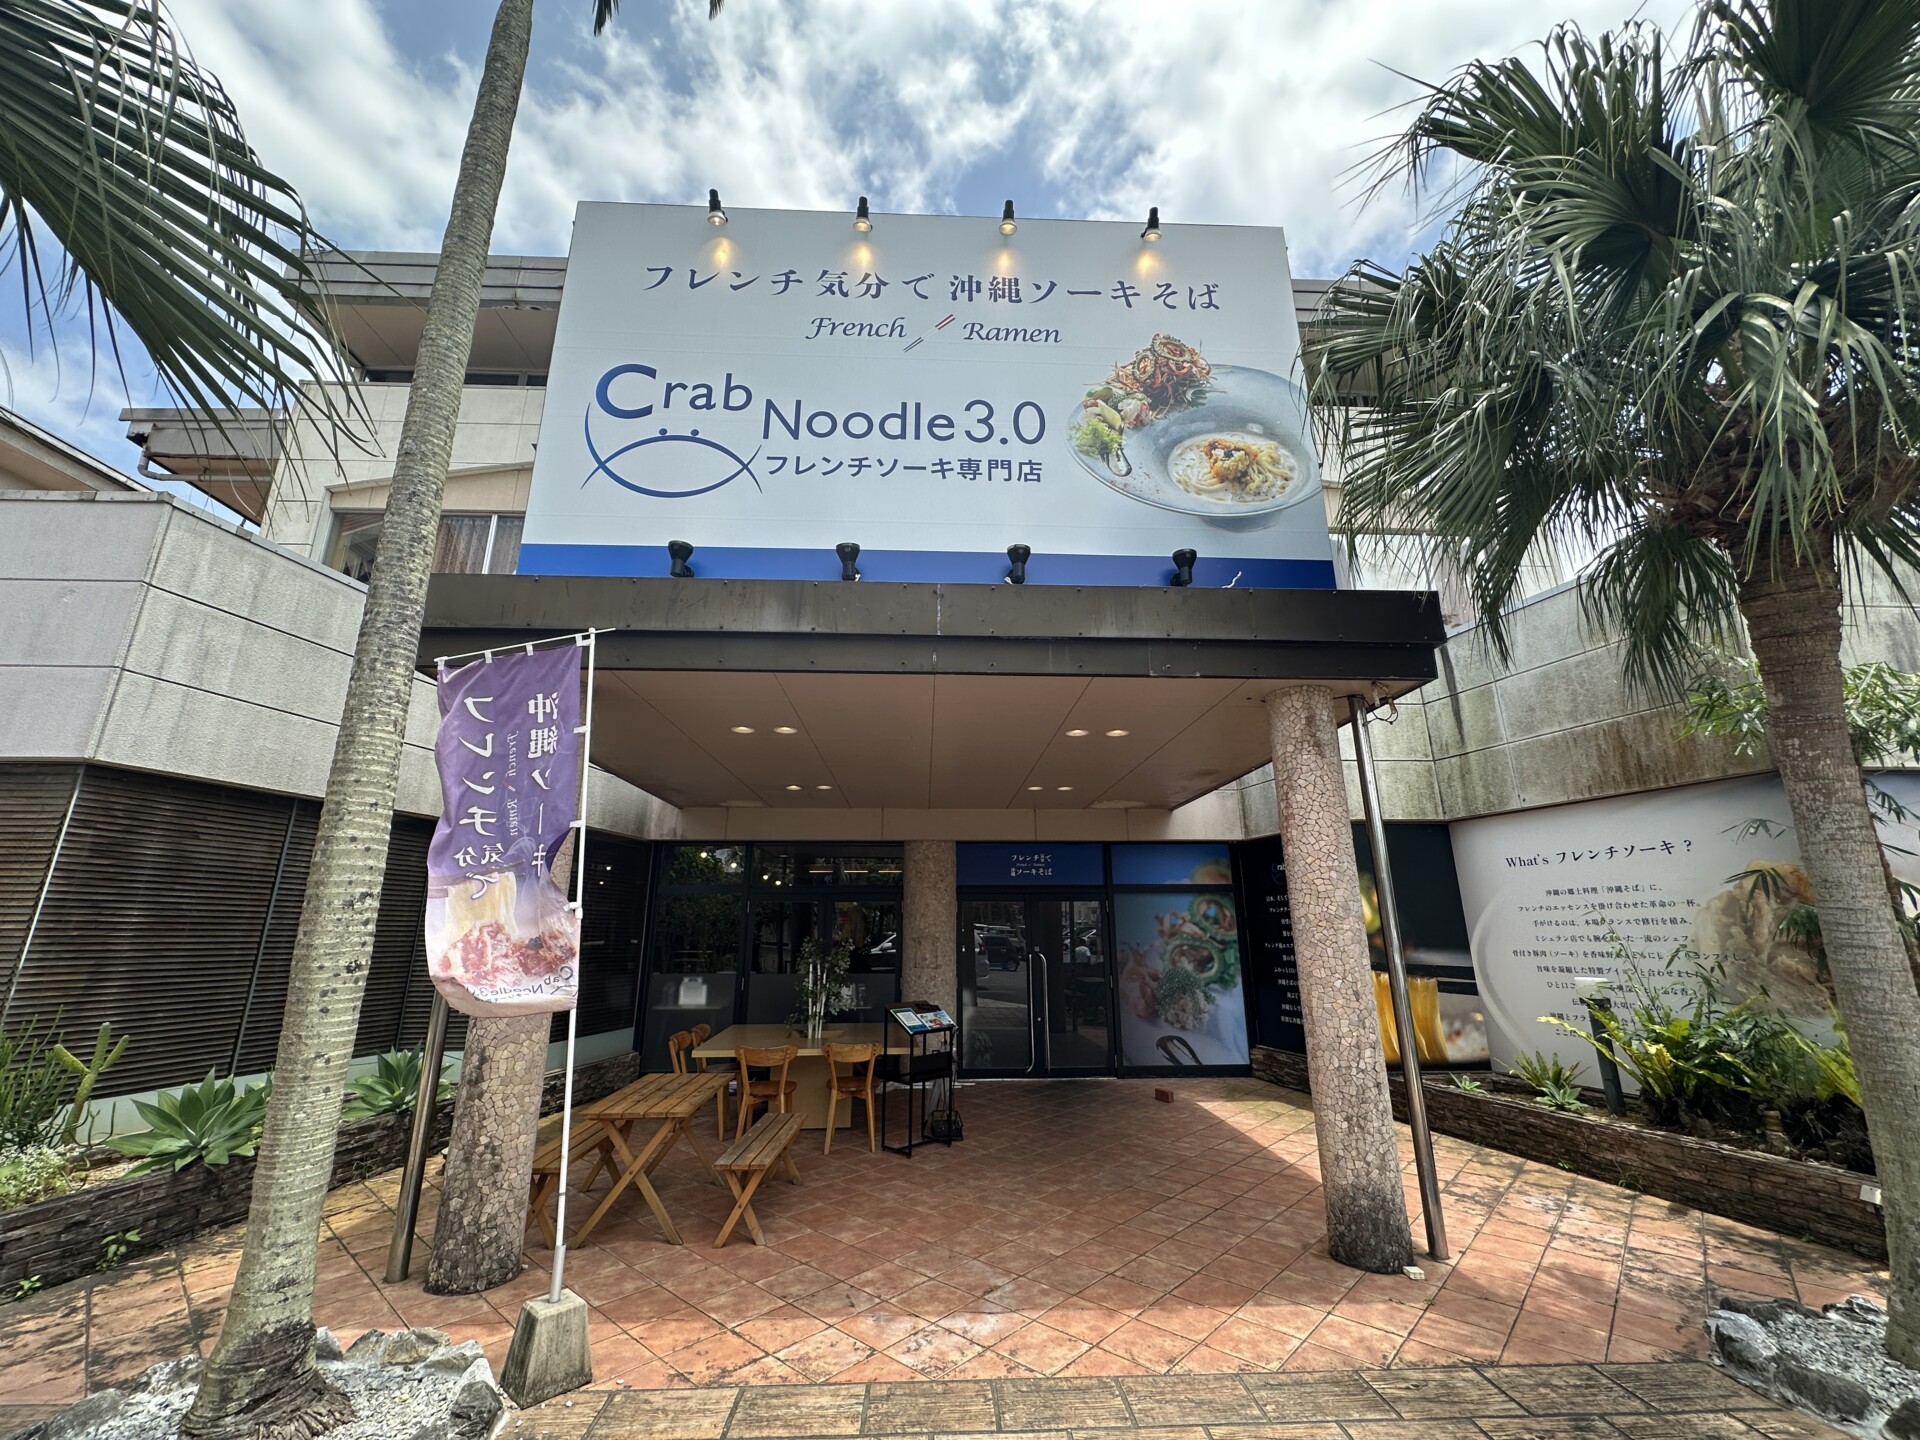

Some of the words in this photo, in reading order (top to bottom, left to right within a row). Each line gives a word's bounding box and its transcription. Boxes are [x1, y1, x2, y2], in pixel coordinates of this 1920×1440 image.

[643, 264, 1221, 311] フレンチ気分で沖縄ソーキそば
[805, 314, 907, 342] French
[962, 321, 1063, 345] Ramen
[595, 363, 754, 419] Crab
[766, 453, 1045, 484] フレンチソーキ専門店
[1505, 853, 1550, 869] What's
